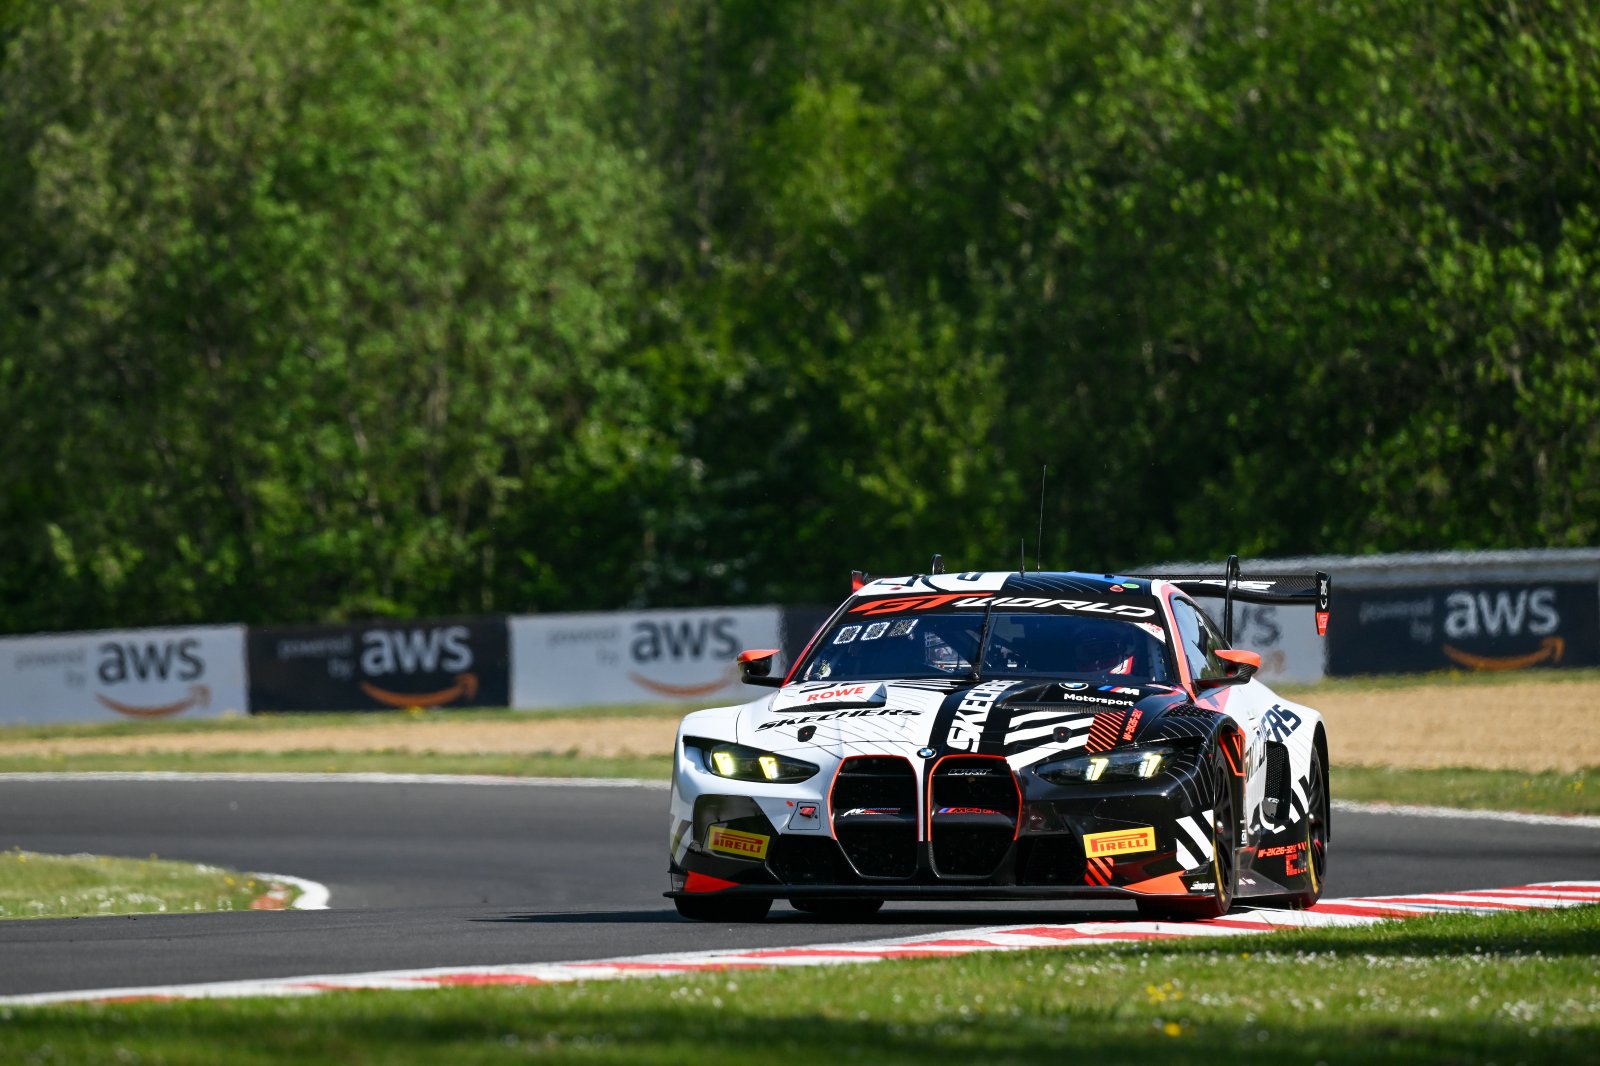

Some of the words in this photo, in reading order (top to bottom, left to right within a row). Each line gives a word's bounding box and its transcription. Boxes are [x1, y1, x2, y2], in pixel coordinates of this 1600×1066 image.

[849, 592, 994, 615] GT
[952, 597, 1156, 618] WORLD
[1444, 588, 1560, 638] aws
[360, 625, 473, 676] aws
[629, 616, 743, 665] aws
[97, 638, 205, 685] aws
[806, 686, 866, 702] ROWE
[1063, 693, 1134, 707] Motorsport
[755, 708, 924, 732] SKECHERS
[713, 831, 763, 853] PIRELLI
[1090, 832, 1148, 853] PIRELLI
